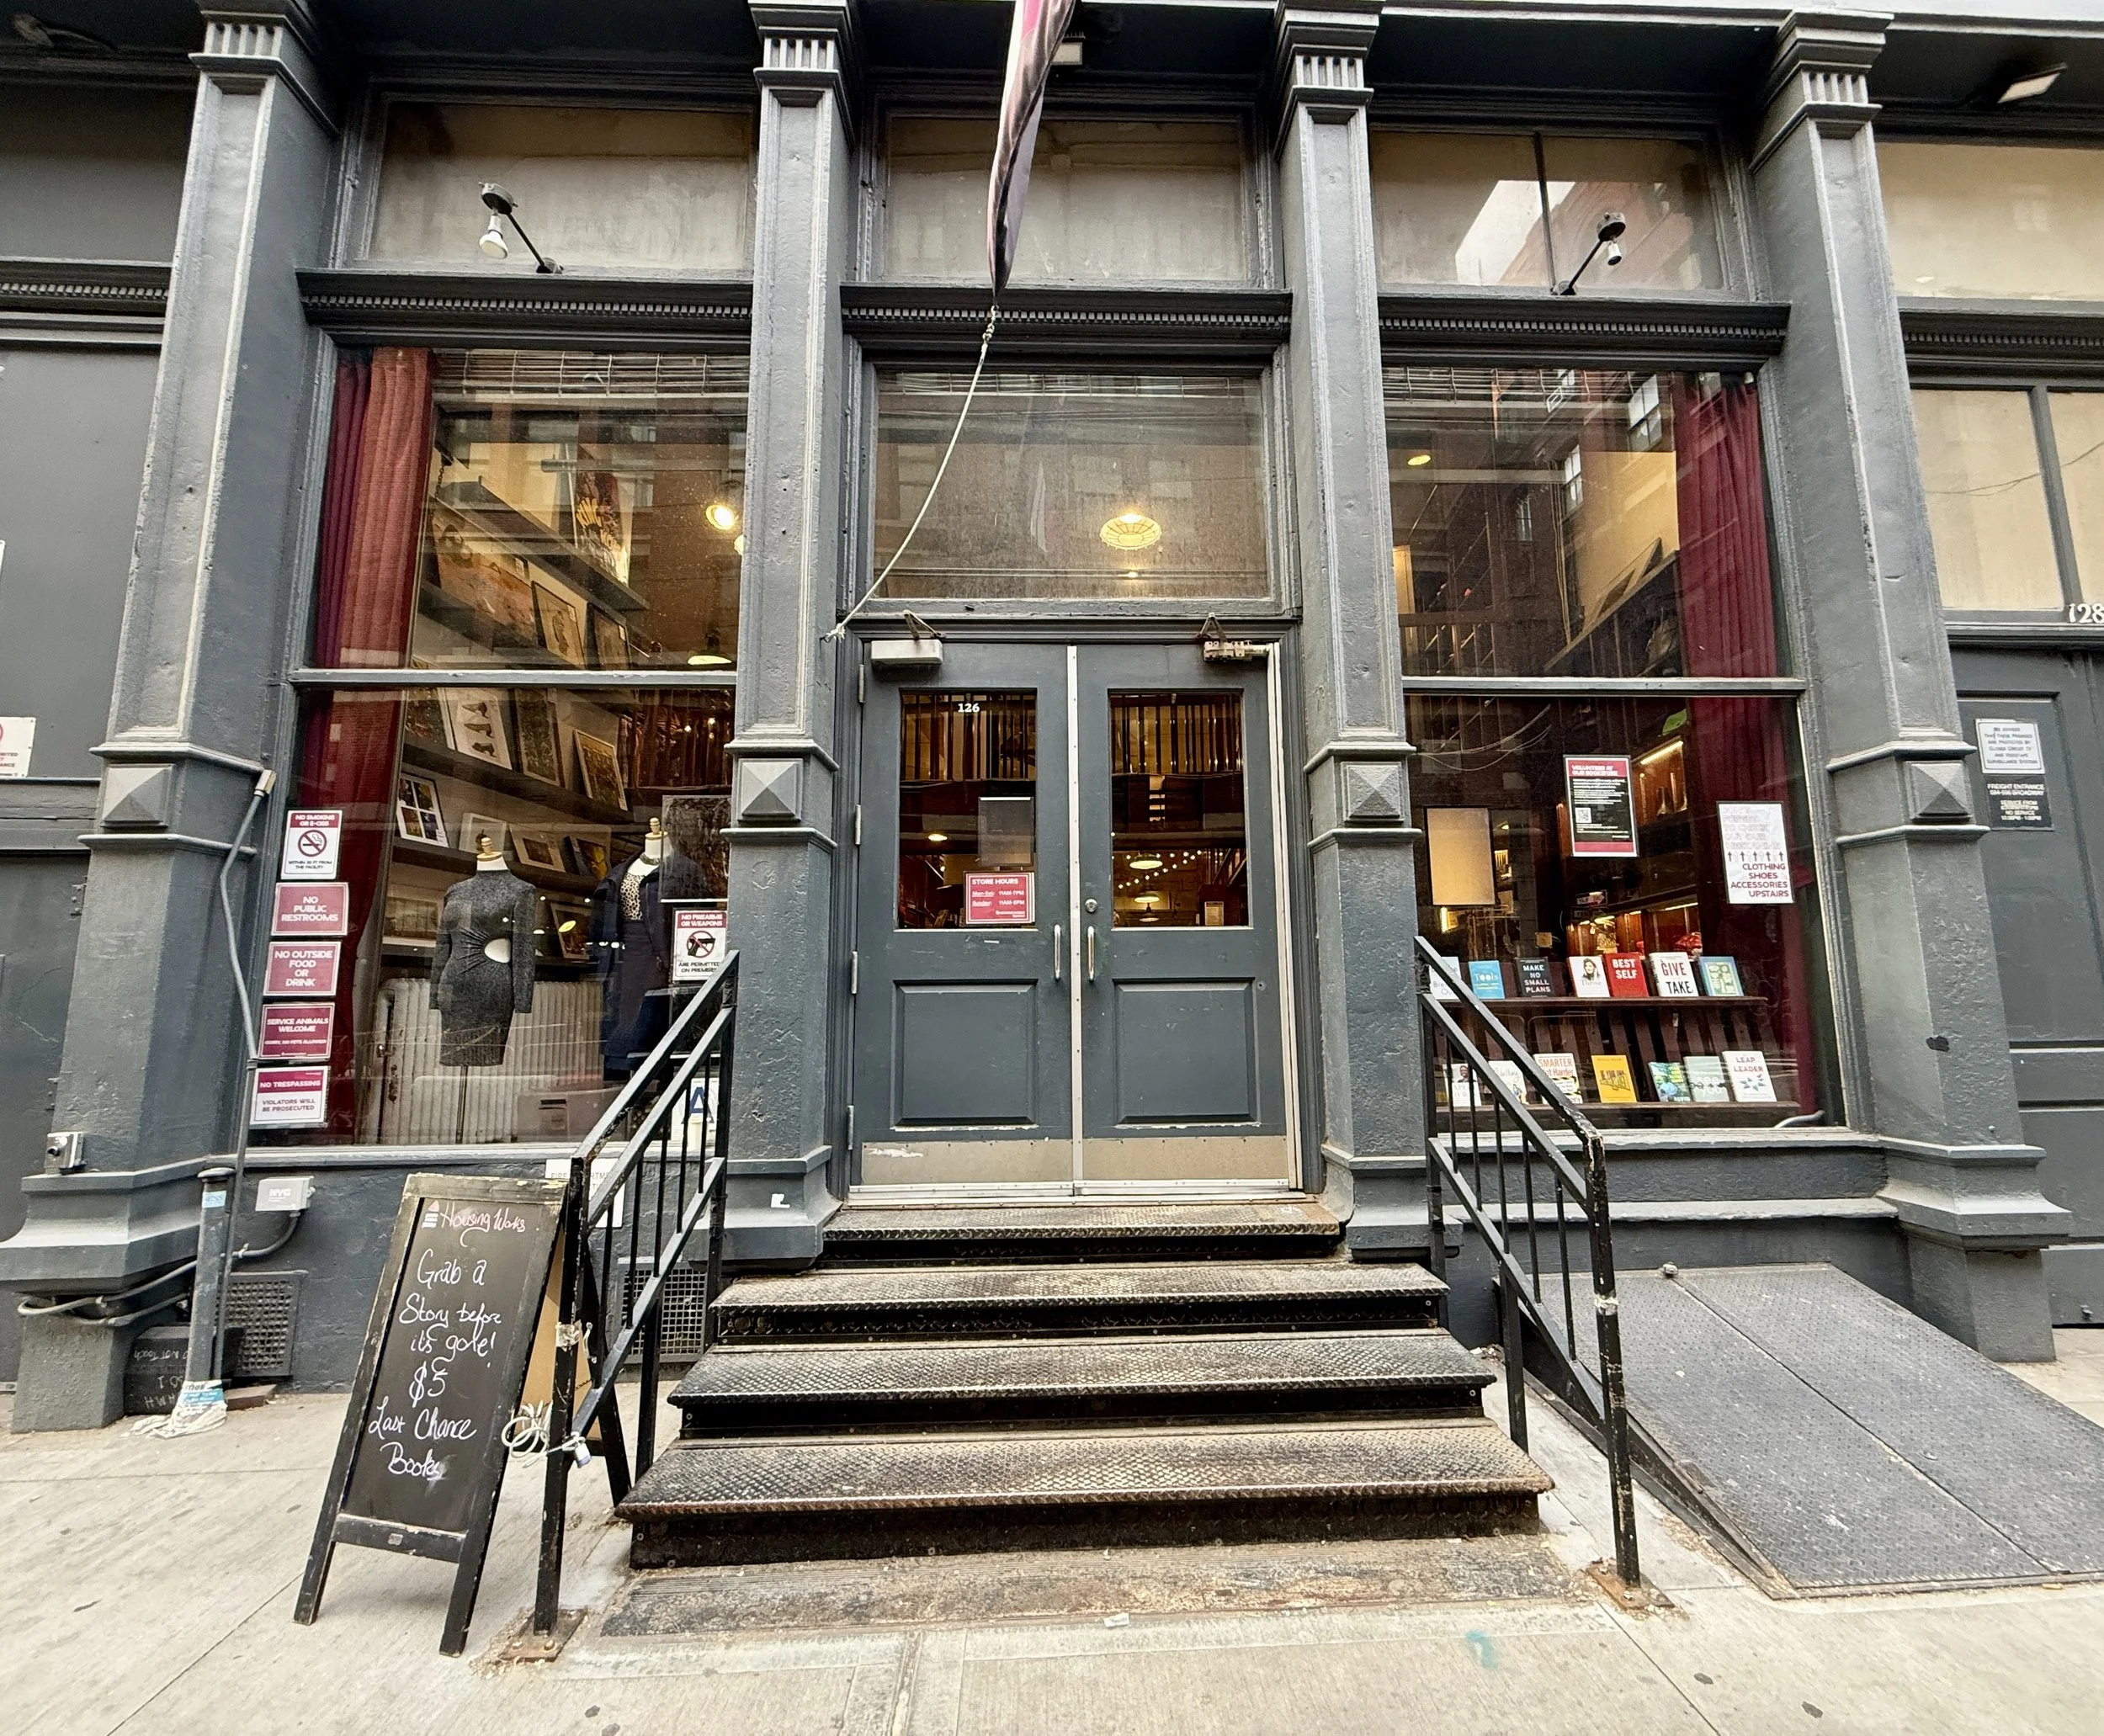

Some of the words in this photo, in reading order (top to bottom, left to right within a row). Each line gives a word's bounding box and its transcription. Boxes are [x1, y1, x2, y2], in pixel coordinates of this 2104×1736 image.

[2069, 603, 2104, 623] 128
[958, 703, 980, 713] 126
[281, 914, 338, 922] RESTROOMS
[1613, 958, 1636, 968] BEST
[1661, 962, 1687, 976] GIVE
[1474, 973, 1499, 981] Tools
[1616, 969, 1638, 979] SELF
[1538, 1059, 1572, 1068] SMARTER
[273, 1080, 321, 1088] TRESPASSING
[417, 1249, 461, 1289] Grab
[473, 1259, 487, 1286] a
[457, 1303, 502, 1340] before
[409, 1361, 448, 1408] $5
[369, 1396, 406, 1440] Last
[415, 1407, 476, 1440] Chance
[380, 1441, 443, 1481] Books
